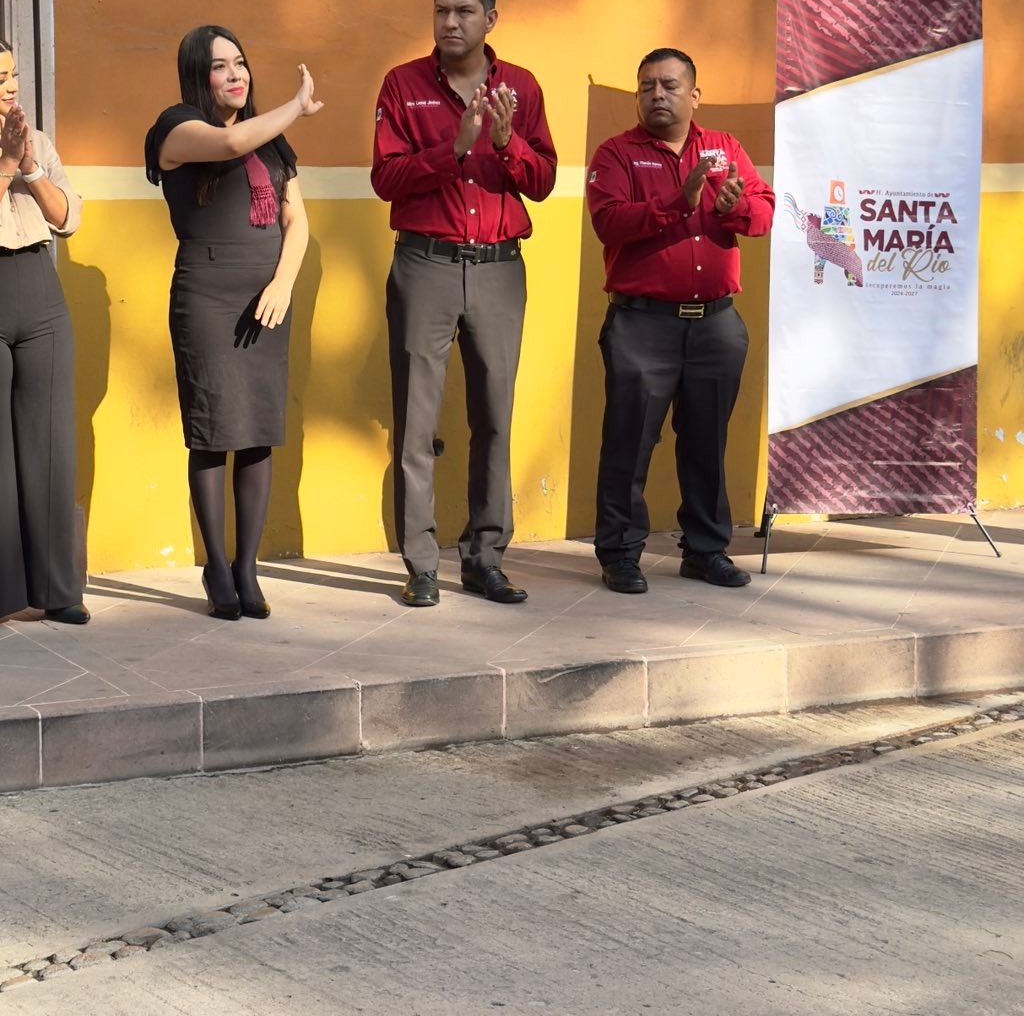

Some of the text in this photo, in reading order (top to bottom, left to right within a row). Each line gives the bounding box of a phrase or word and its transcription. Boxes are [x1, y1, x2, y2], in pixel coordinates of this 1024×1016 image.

[885, 190, 926, 198] Ayuntamiento
[860, 198, 958, 224] SANTA
[863, 224, 955, 254] MARÍA
[867, 252, 897, 272] del
